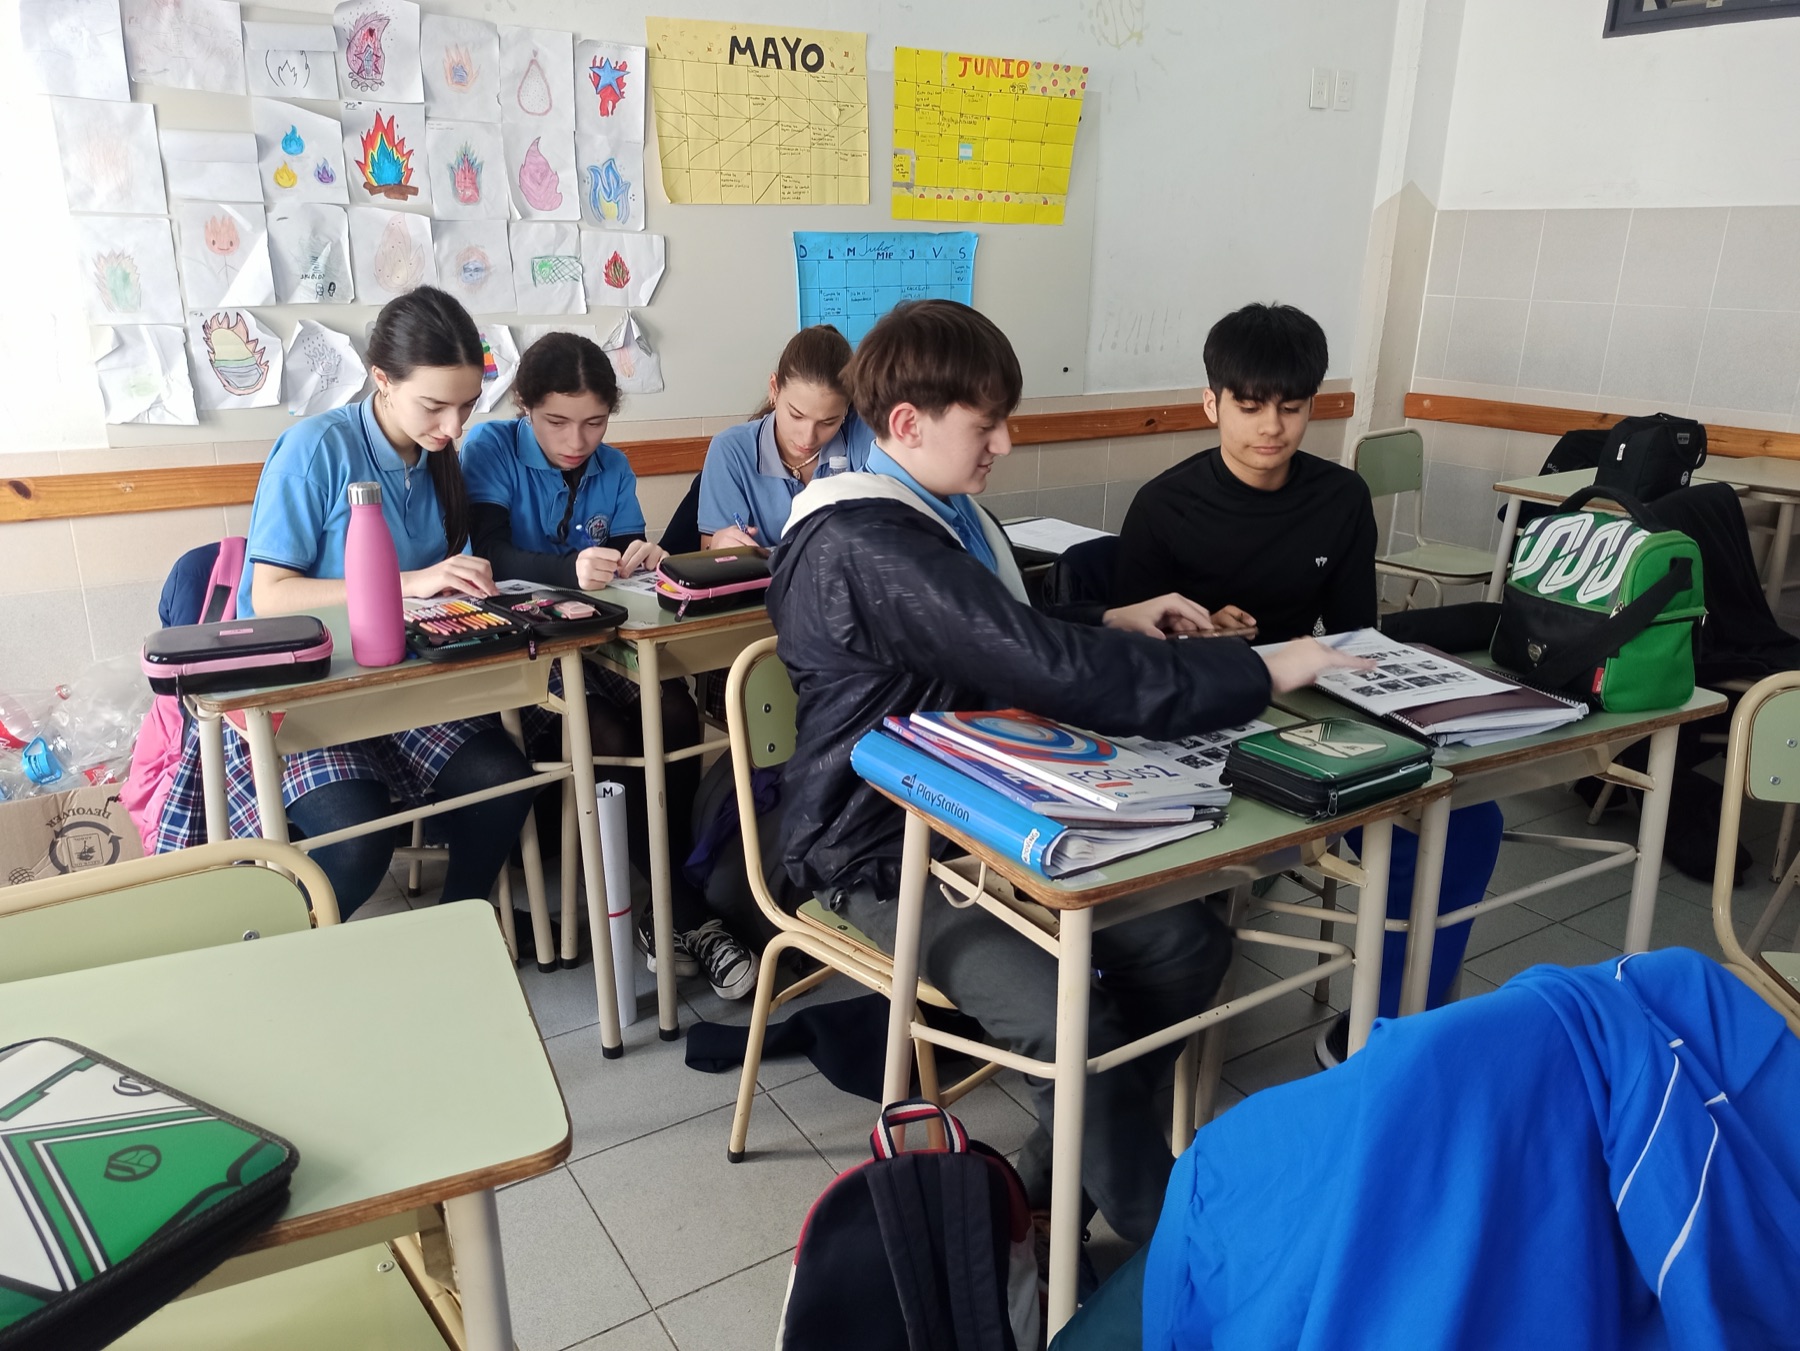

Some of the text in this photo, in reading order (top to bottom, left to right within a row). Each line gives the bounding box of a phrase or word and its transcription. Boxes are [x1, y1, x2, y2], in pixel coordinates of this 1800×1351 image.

[729, 35, 825, 73] MAYO
[958, 56, 1030, 79] JUNIO
[799, 245, 808, 258] D
[828, 249, 834, 259] L
[847, 247, 856, 257] M
[909, 249, 915, 259] J
[932, 246, 943, 259] V
[958, 246, 967, 259] S
[1066, 768, 1161, 783] FOCUS
[1143, 764, 1181, 778] 2
[916, 783, 970, 823] PlayStation
[45, 807, 112, 828] DEVOLVER
